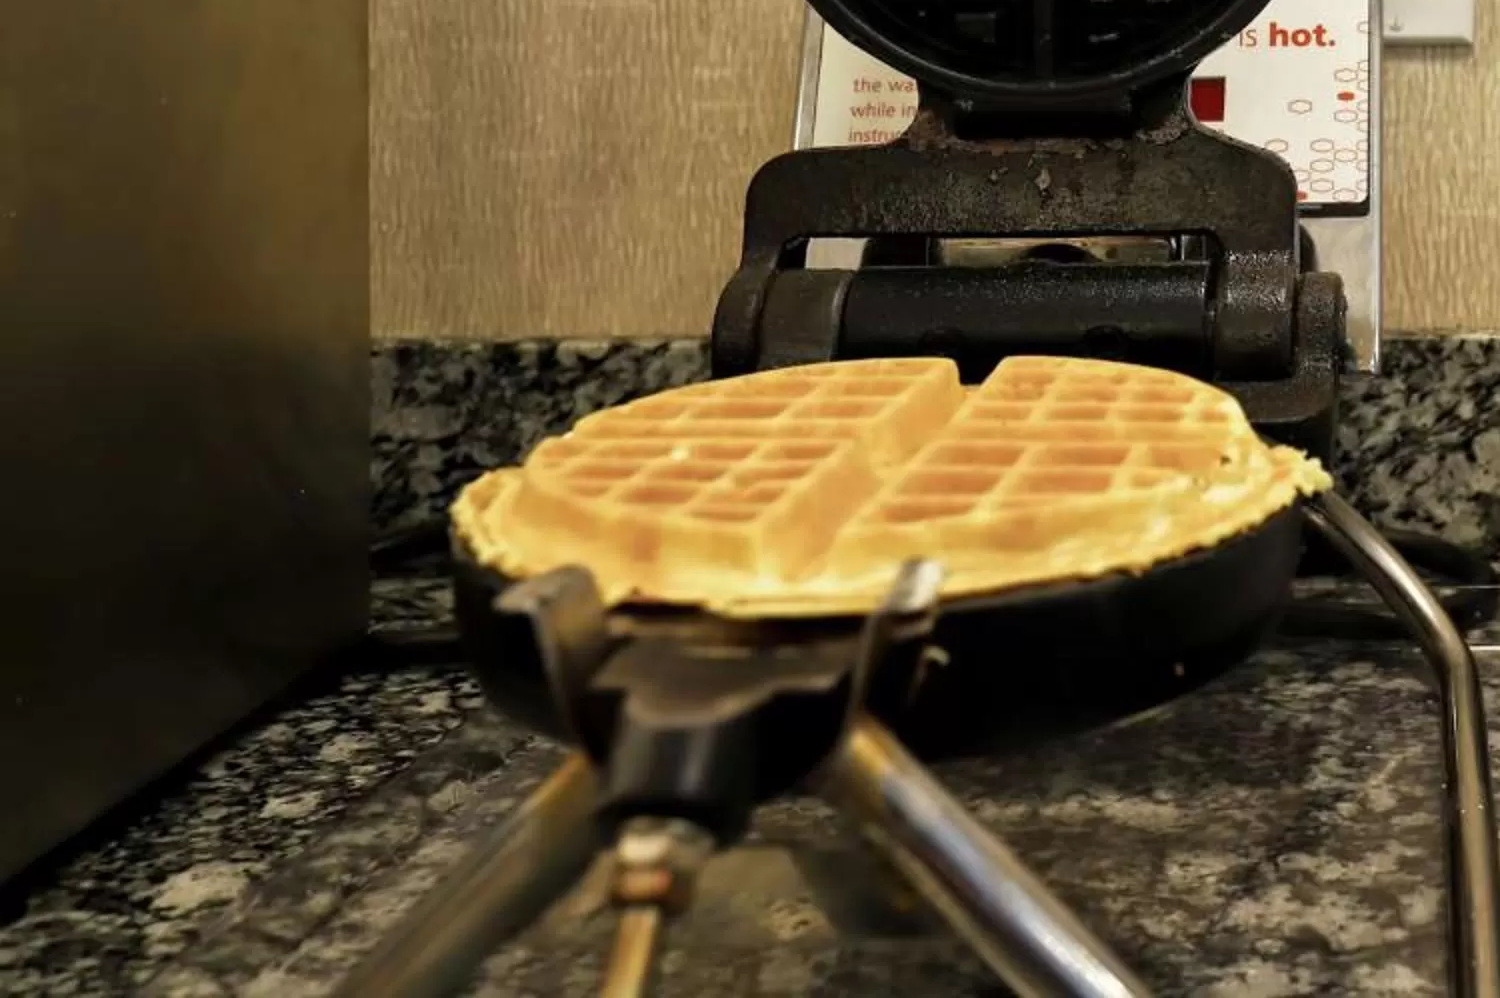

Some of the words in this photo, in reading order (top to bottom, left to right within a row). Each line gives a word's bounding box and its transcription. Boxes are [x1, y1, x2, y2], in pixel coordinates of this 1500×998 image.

[1269, 20, 1336, 47] hot.
[853, 78, 882, 93] the
[850, 102, 897, 117] while
